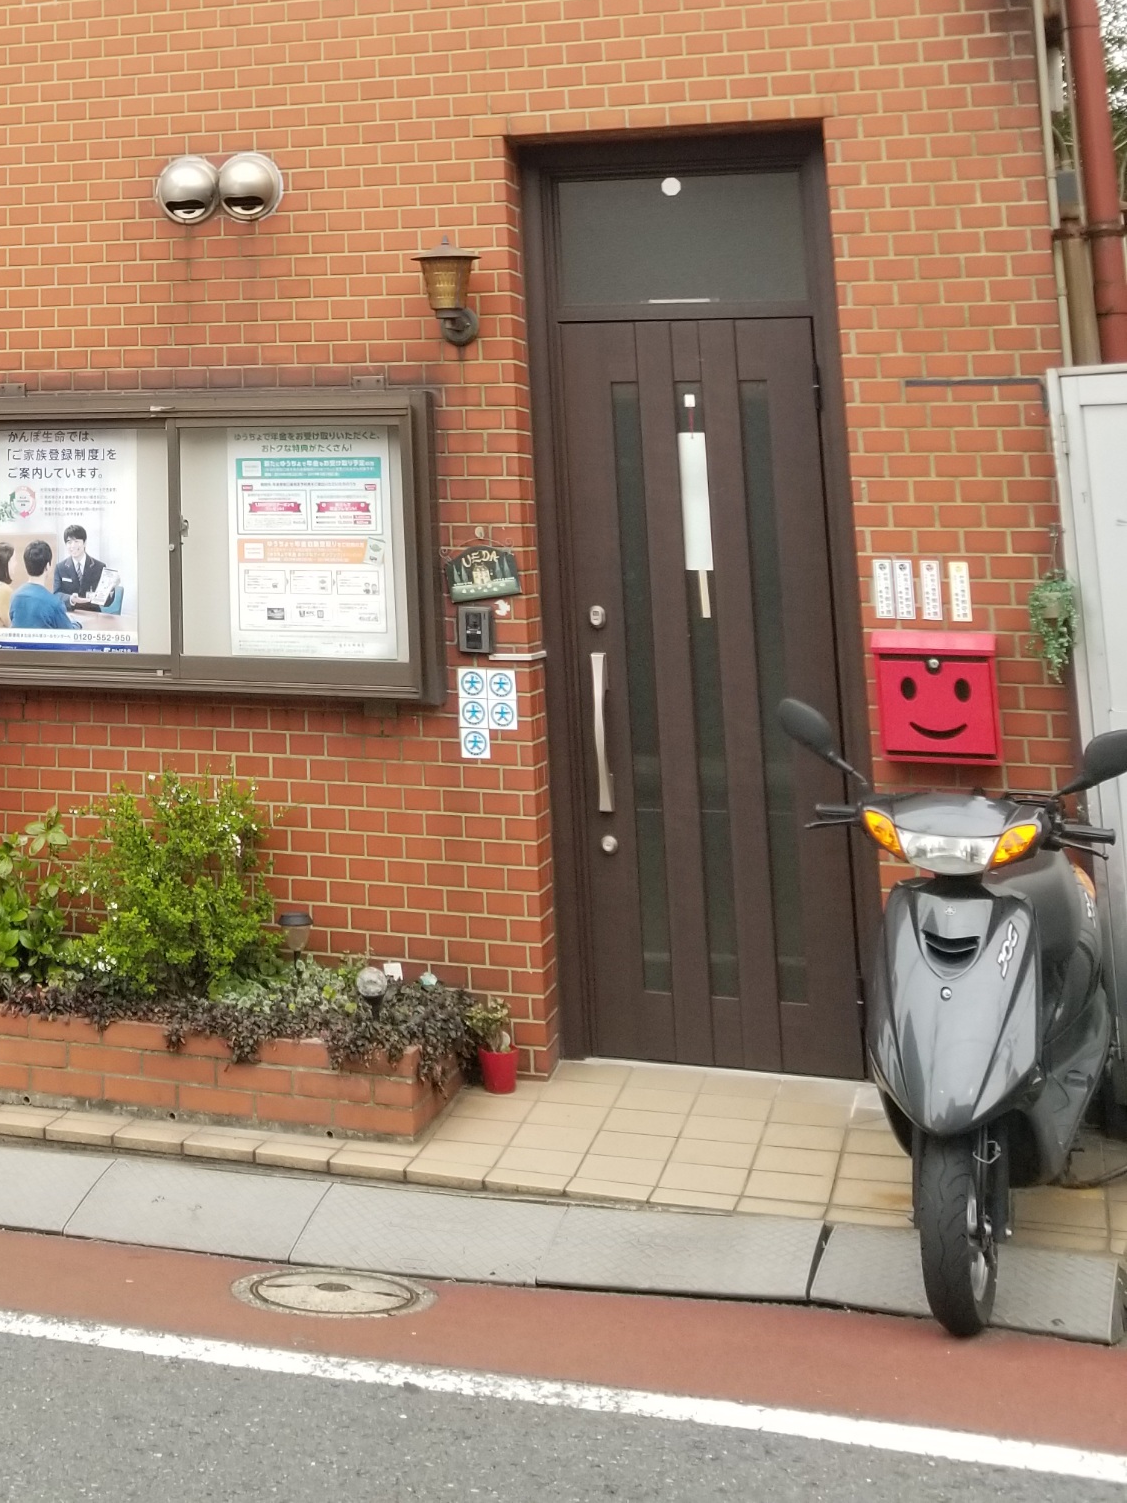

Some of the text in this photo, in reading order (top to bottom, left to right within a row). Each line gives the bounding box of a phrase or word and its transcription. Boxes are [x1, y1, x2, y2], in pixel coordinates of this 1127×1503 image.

[8, 430, 95, 443] かんぽ生命では、
[234, 431, 380, 441] ゆうちょで年金をお受け取りいただくと、
[7, 448, 117, 461] 「ご家族登録制度」を
[8, 467, 103, 479] ご案内しています。
[462, 549, 500, 568] UEDA
[73, 633, 131, 642] 0120-552-950
